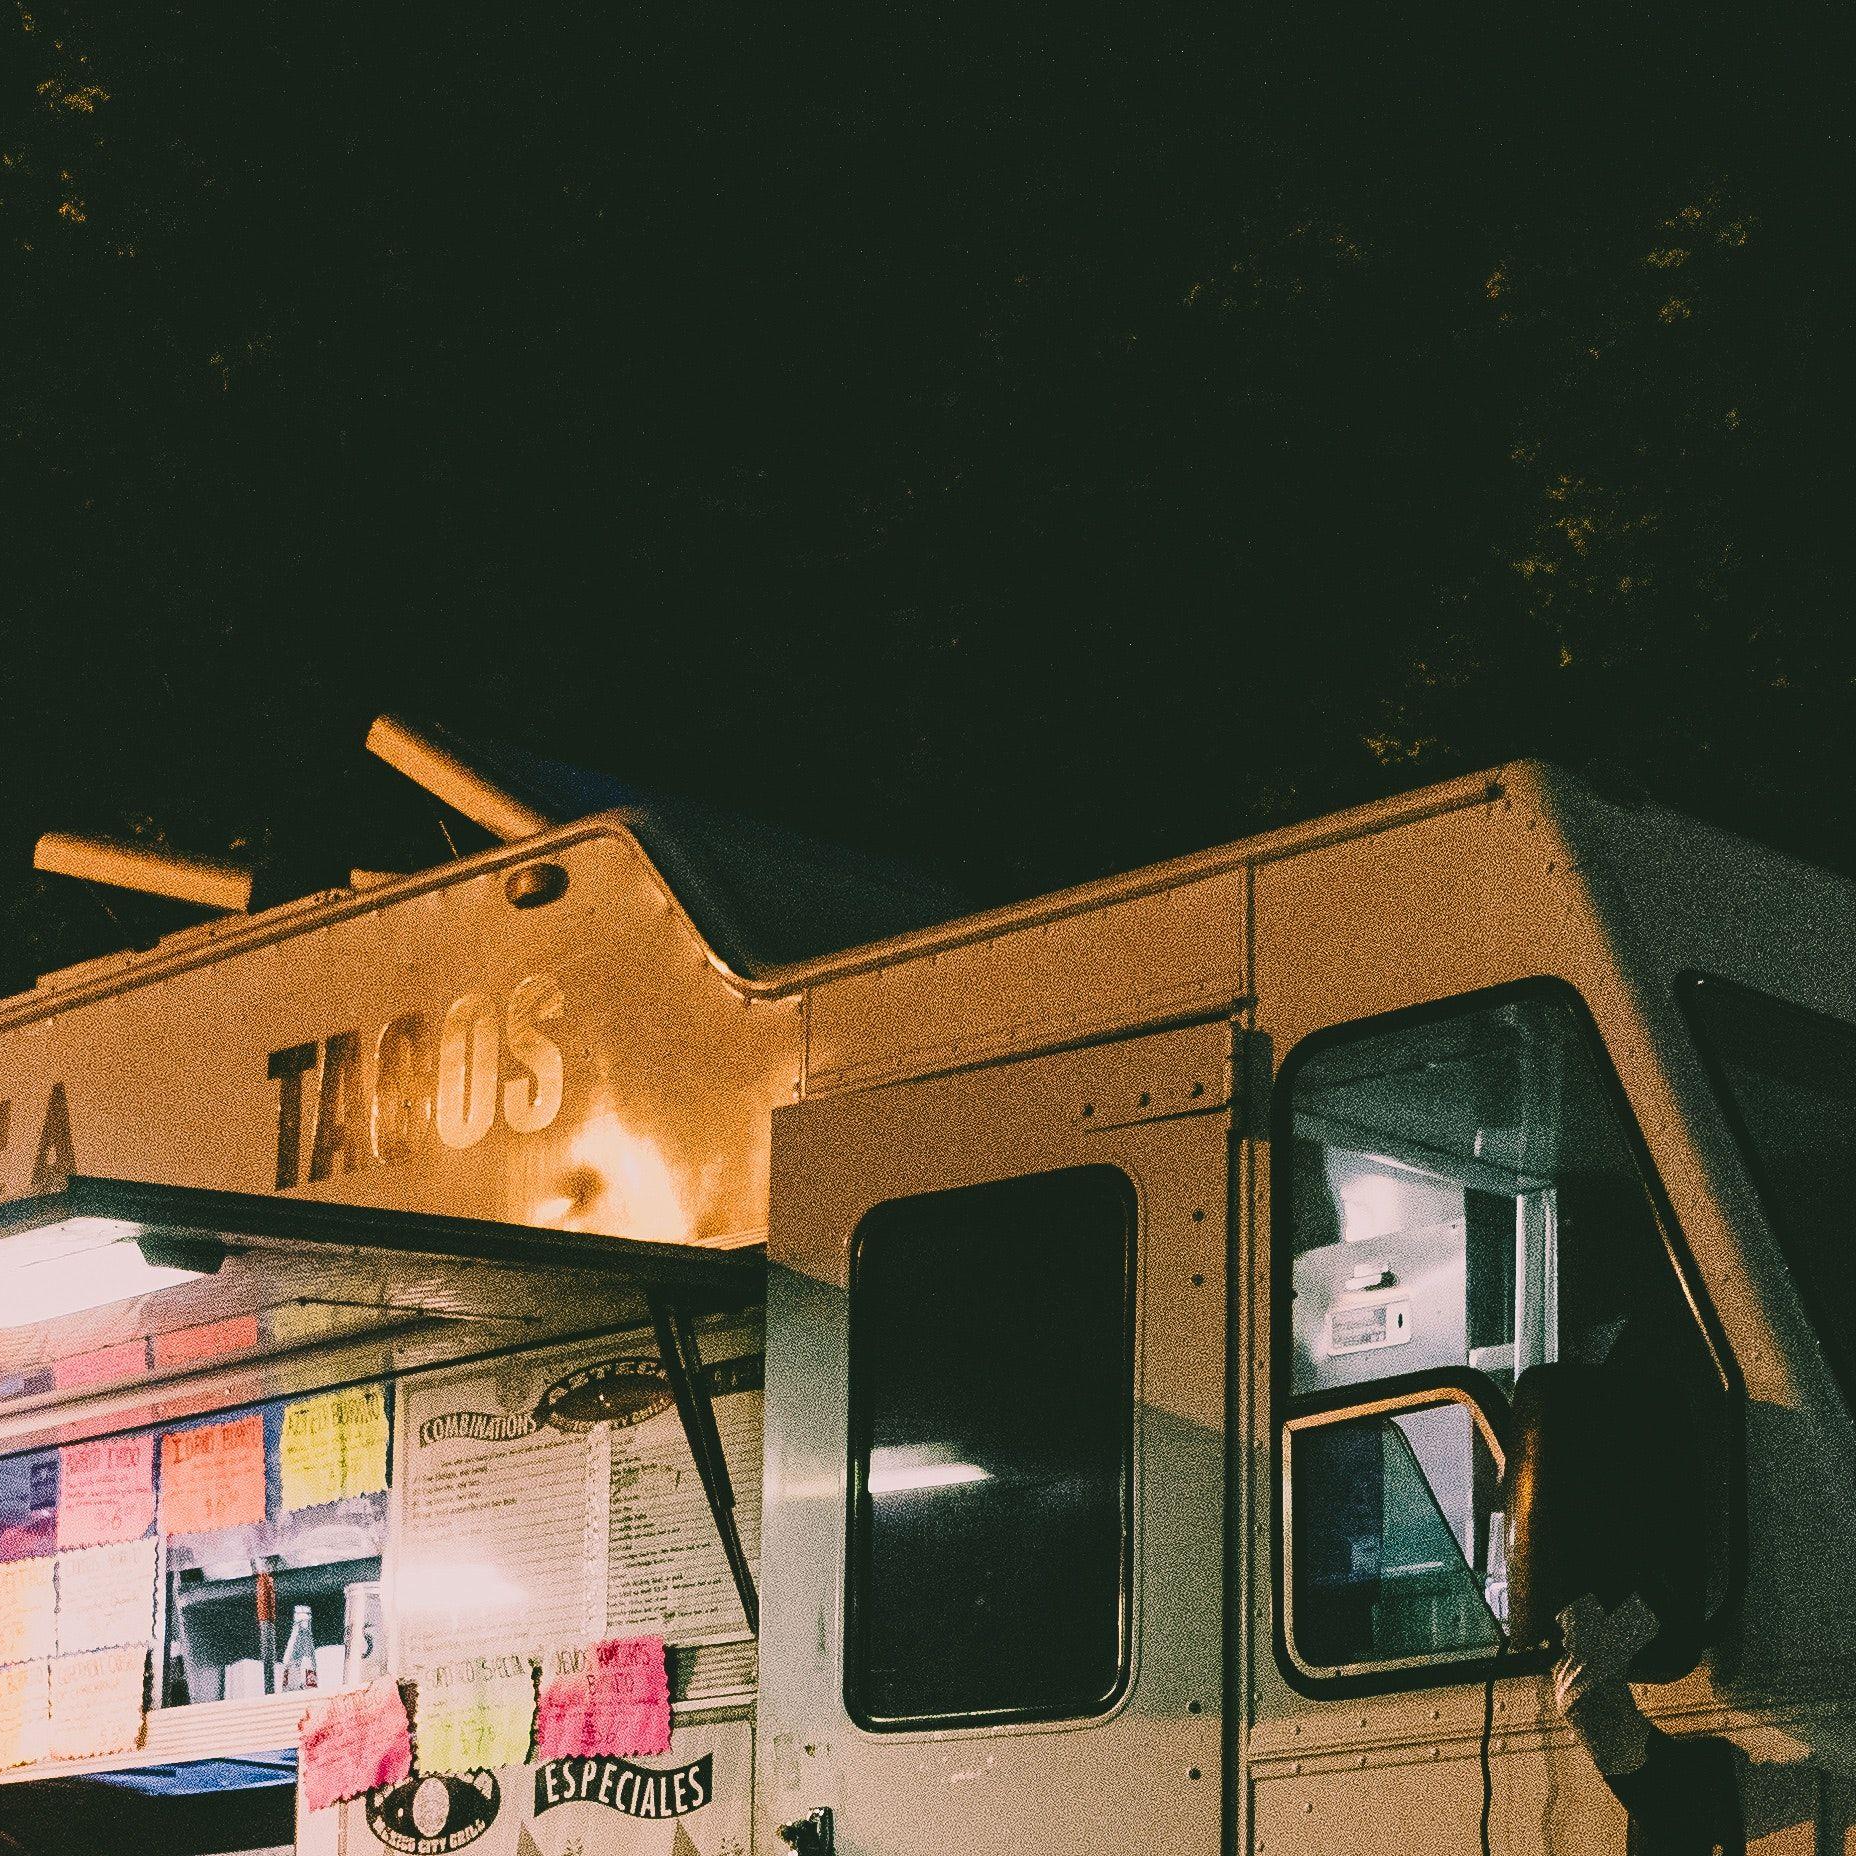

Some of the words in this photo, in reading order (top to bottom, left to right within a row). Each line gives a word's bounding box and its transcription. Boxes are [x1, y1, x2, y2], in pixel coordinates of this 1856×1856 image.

[266, 974, 564, 1191] TACOS
[421, 1412, 538, 1443] COMBINATIONS
[543, 1760, 704, 1818] ESPECIALES
[418, 1839, 446, 1854] CITY
